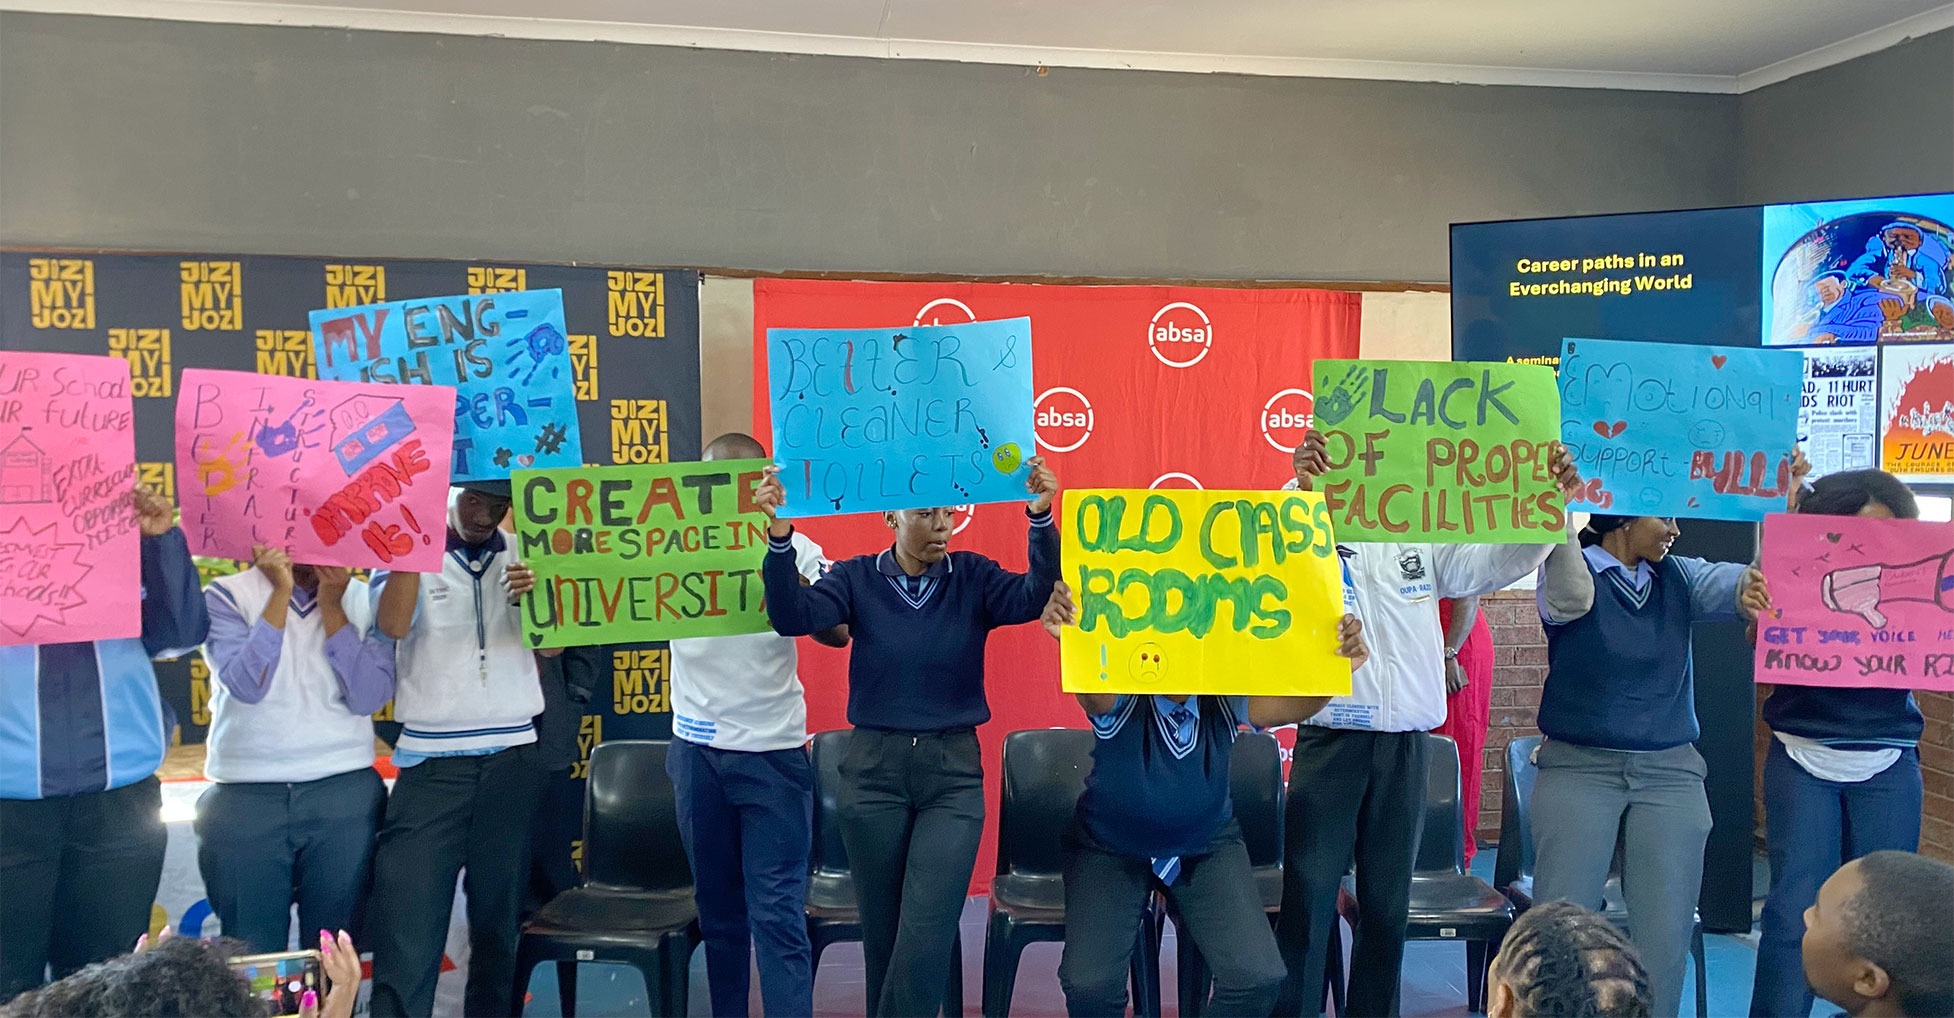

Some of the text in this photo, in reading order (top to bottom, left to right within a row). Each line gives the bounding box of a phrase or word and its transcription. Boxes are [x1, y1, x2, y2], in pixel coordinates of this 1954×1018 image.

[1517, 252, 1684, 273] Career paths in an
[31, 281, 82, 315] MY
[181, 283, 231, 318] MY
[1509, 273, 1693, 296] Everchanging World
[608, 291, 655, 324] MY
[321, 309, 390, 367] MY
[1155, 322, 1206, 344] absa
[334, 339, 494, 386] ISH IS
[1516, 355, 1562, 365] semina
[50, 366, 129, 400] School
[1369, 368, 1520, 430] LACK
[1828, 380, 1839, 394] 11
[1842, 380, 1875, 394] HURT
[1036, 405, 1087, 428] absa
[1826, 394, 1855, 408] RIOT
[611, 419, 658, 453] MY
[1324, 428, 1390, 477] OF
[1895, 441, 1954, 461] JUNE
[788, 451, 985, 503] TOILETS
[523, 471, 765, 527] CREATE
[1324, 478, 1565, 535] FACILITIES
[521, 519, 768, 560] MORE SPACE IN
[1076, 494, 1184, 554] OLD
[527, 568, 766, 633] UnIVERSIT
[1078, 563, 1292, 640] ROOMS
[1763, 626, 1807, 645] GET
[1871, 629, 1917, 643] VOICE
[1853, 653, 1908, 676] YOUR
[613, 671, 662, 704] MY
